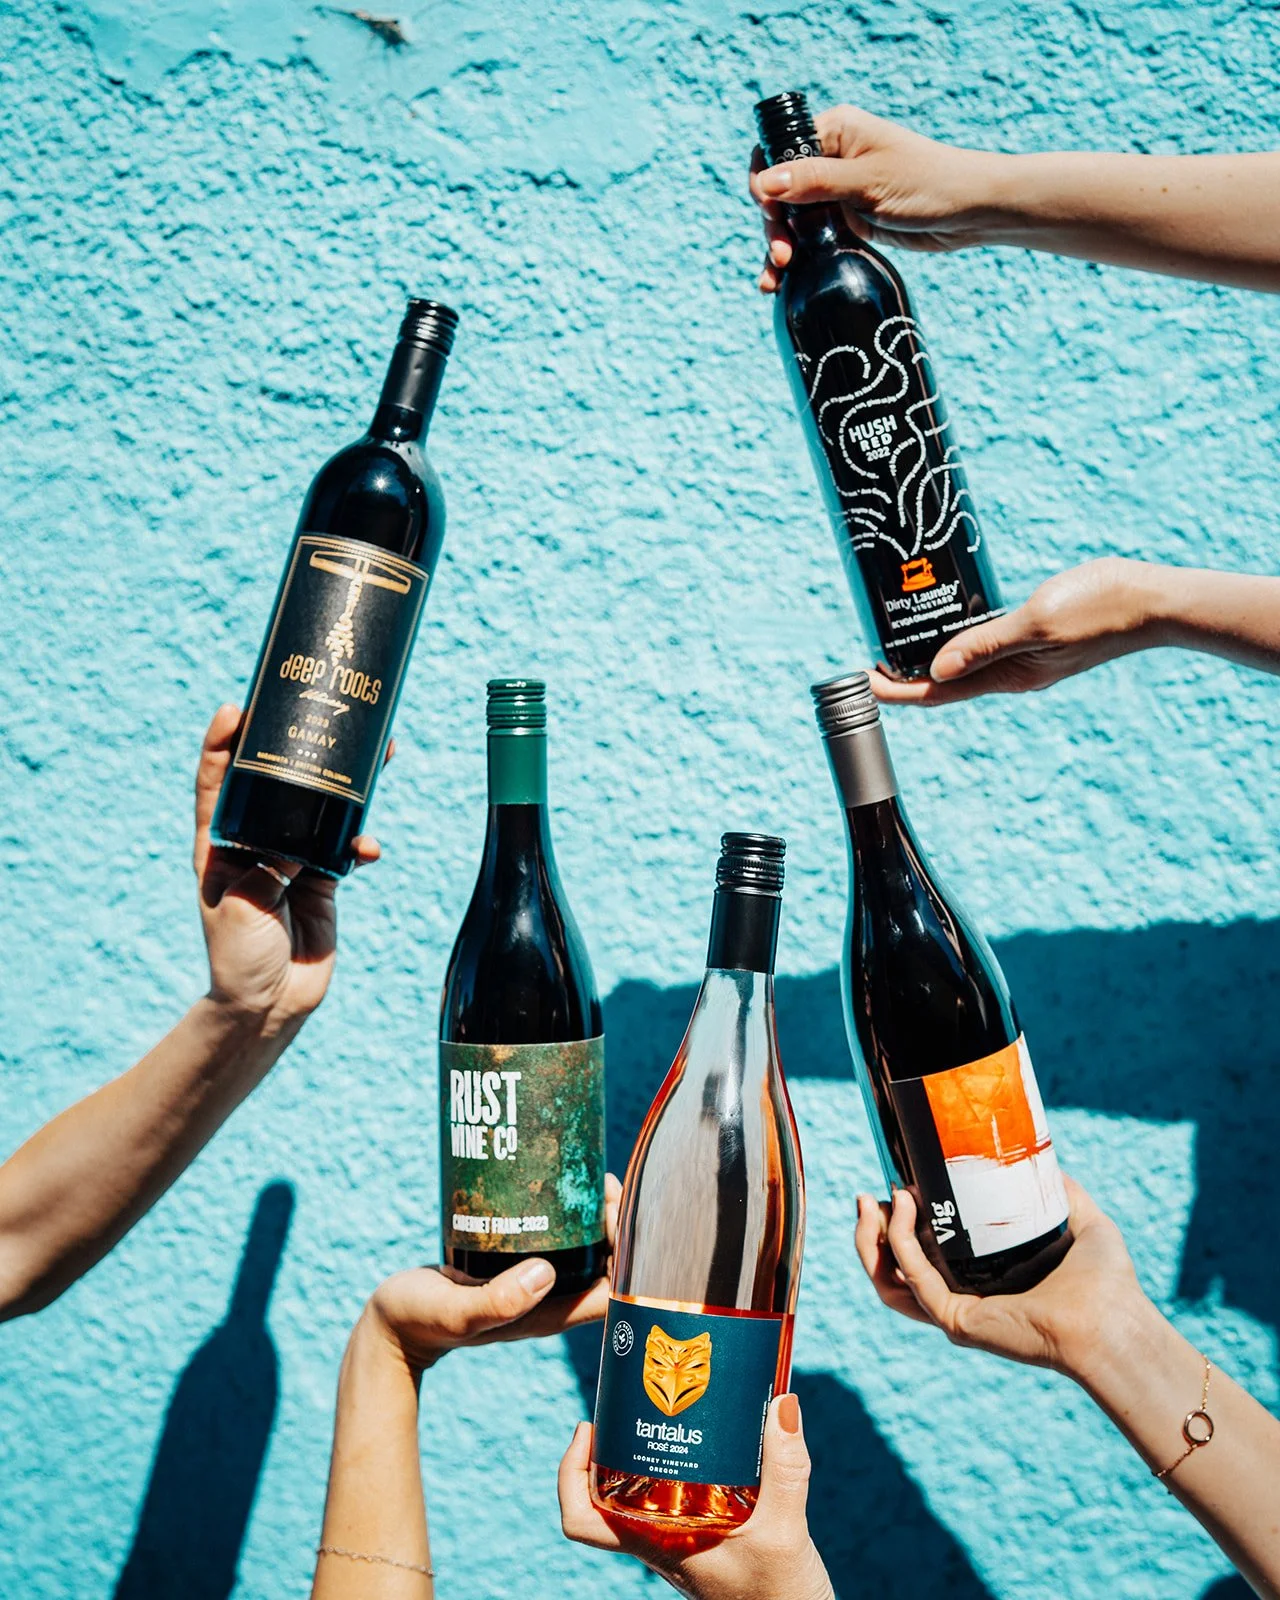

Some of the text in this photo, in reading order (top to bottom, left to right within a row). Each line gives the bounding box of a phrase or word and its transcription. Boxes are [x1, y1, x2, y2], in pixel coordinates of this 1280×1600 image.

[849, 414, 898, 443] HUSH
[860, 432, 893, 452] RED
[865, 446, 891, 462] 2022
[885, 597, 911, 612] Dirty
[911, 595, 954, 613] VINEYARD
[279, 653, 382, 705] deep roots
[288, 725, 336, 749] GAMAY
[450, 1069, 521, 1125] RUST
[451, 1123, 489, 1160] WINE
[931, 1200, 956, 1245] Vig
[636, 1418, 703, 1444] tantalus
[647, 1441, 689, 1455] ROSÉ 2024
[633, 1455, 699, 1469] LOONEY VINEYARD
[648, 1466, 679, 1475] OREGON
